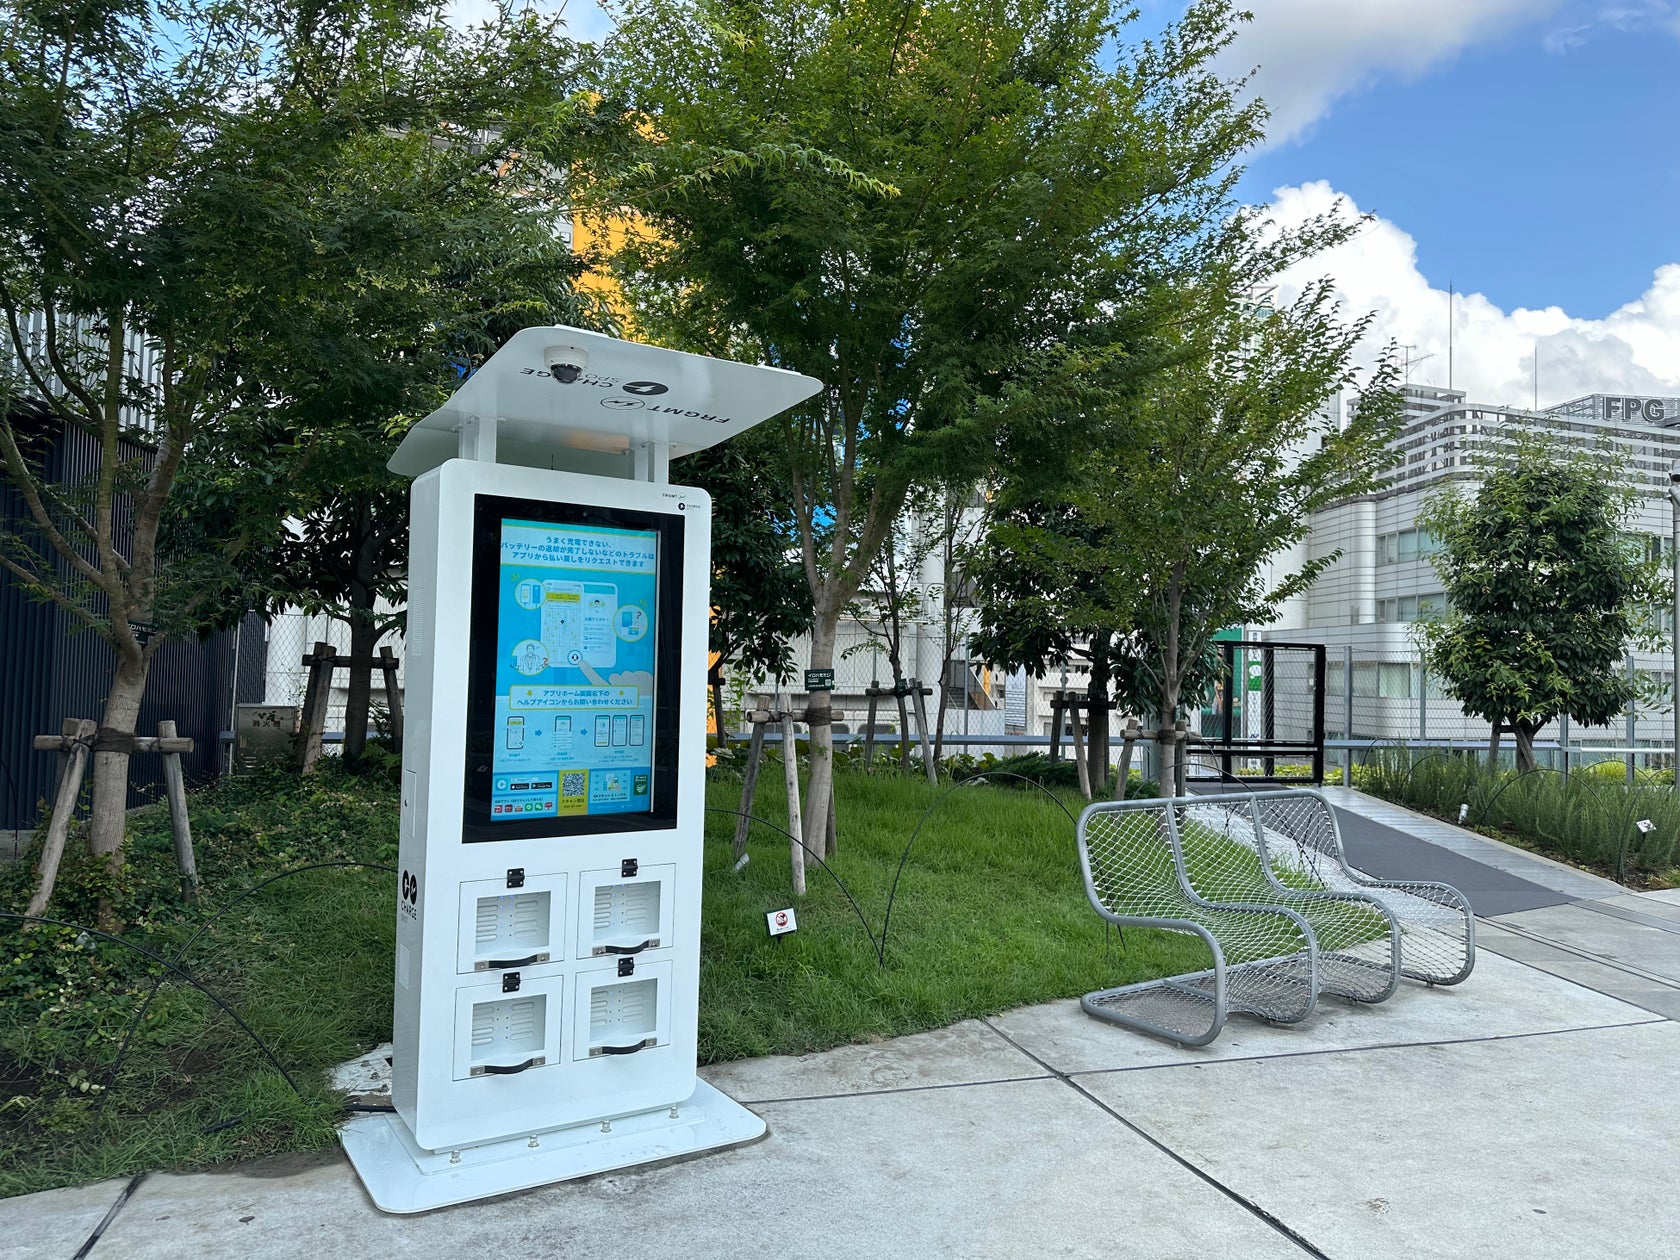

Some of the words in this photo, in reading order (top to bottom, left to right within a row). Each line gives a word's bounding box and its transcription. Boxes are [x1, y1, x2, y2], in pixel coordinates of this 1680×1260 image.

[520, 366, 613, 388] CHGE
[584, 373, 621, 383] SPO
[646, 405, 731, 424] FRGMT
[1602, 396, 1665, 422] FPG
[512, 551, 644, 567] アプリから払い戻しをリクエストできます
